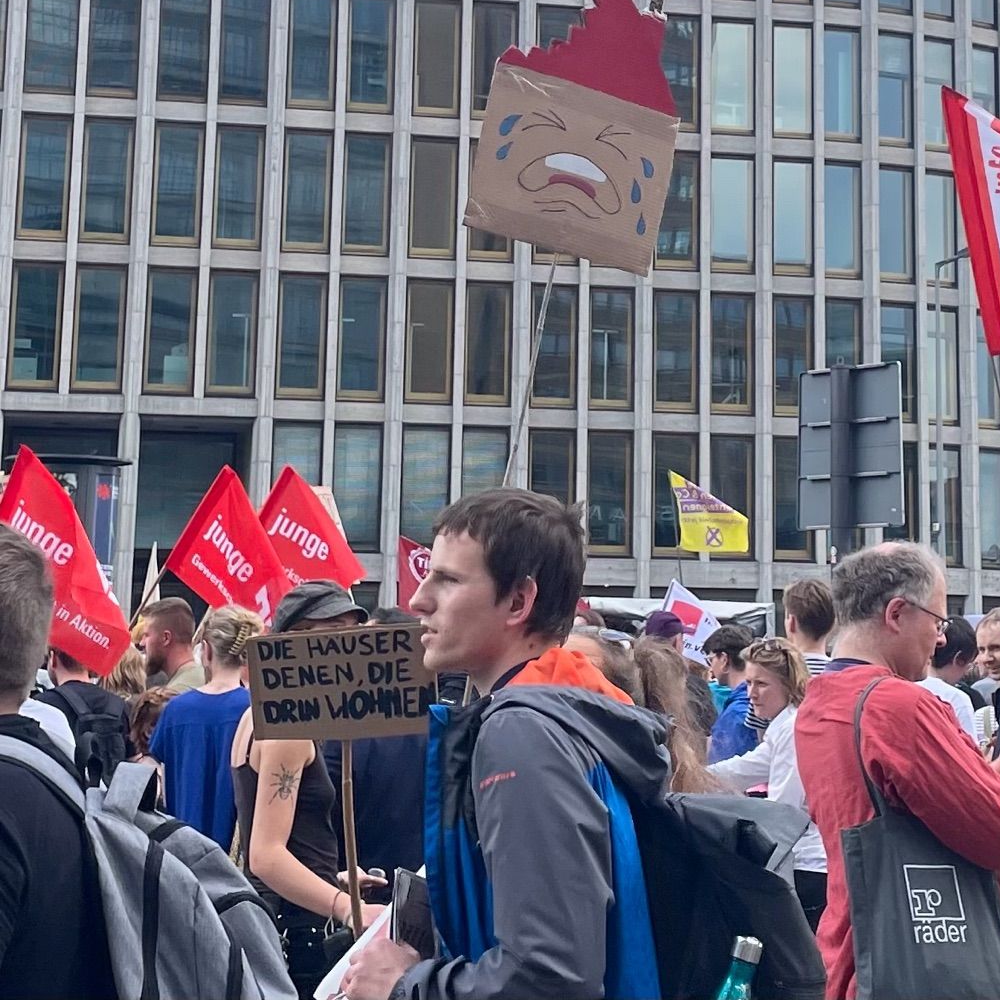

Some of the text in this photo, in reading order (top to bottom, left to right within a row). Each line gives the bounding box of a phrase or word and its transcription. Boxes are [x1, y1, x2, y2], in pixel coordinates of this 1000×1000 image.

[203, 514, 254, 582] junge
[268, 507, 330, 561] junge
[257, 629, 413, 662] DIE HÄUSER
[367, 658, 413, 684] DIE
[263, 697, 321, 724] DRIN
[914, 919, 967, 943] räder
